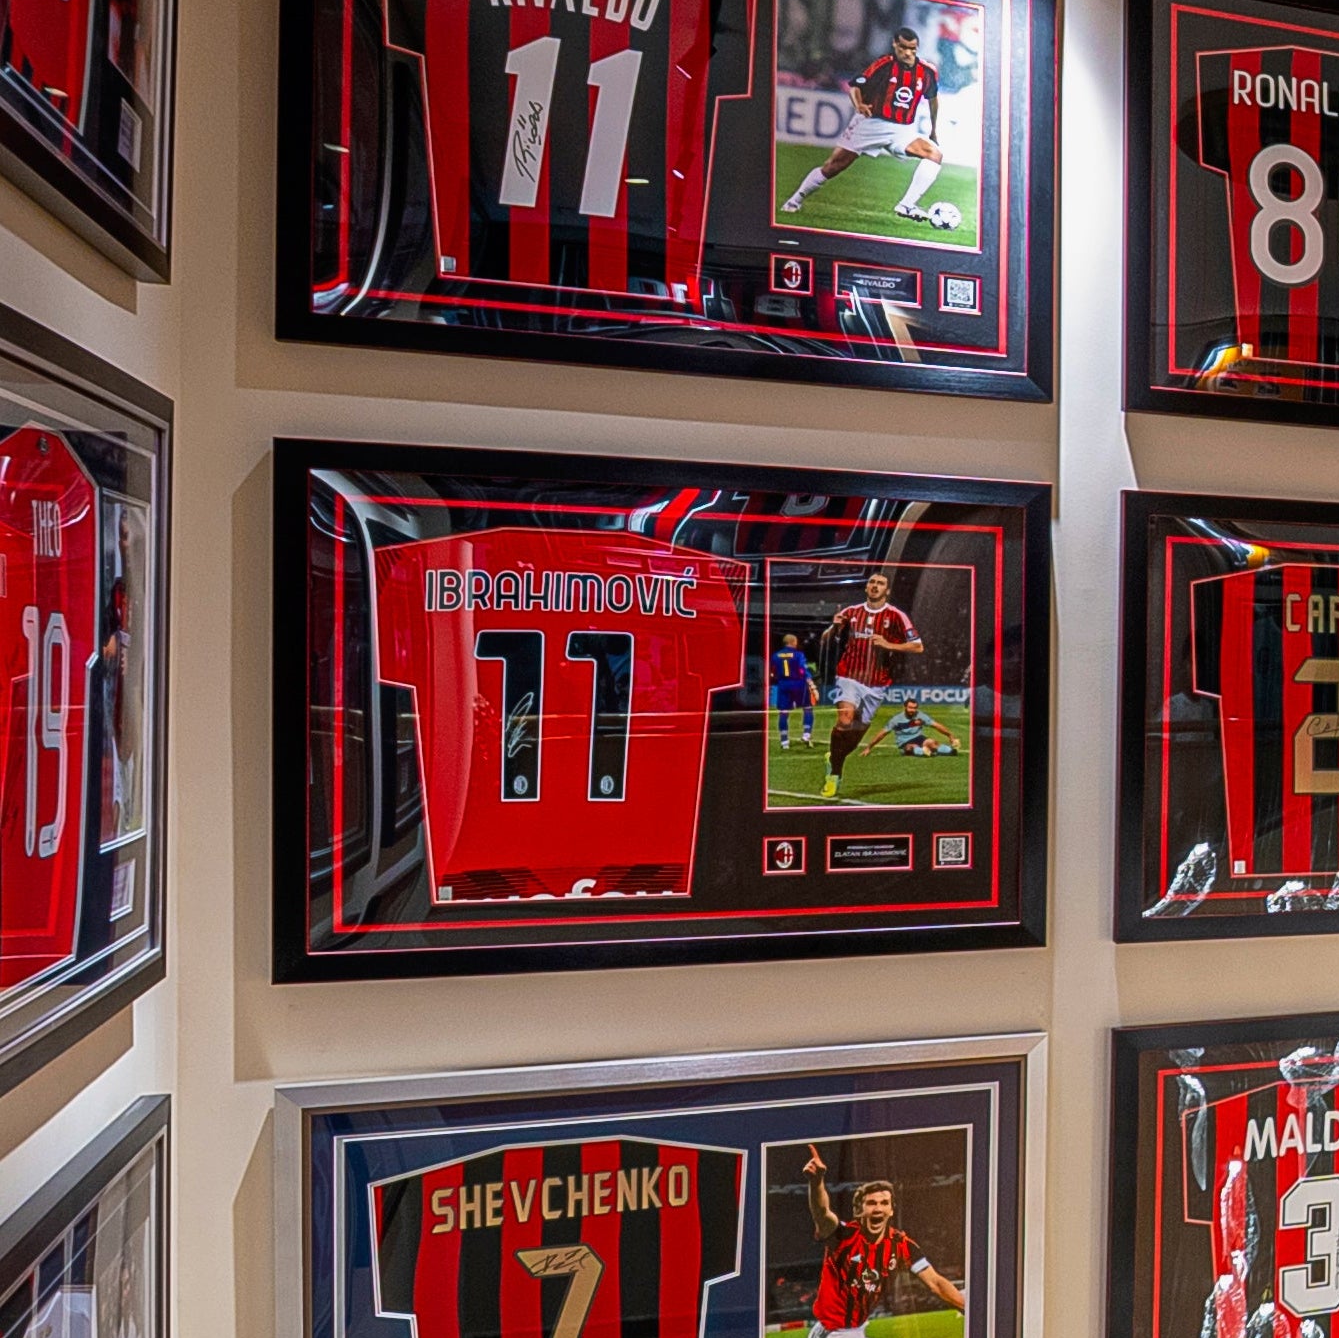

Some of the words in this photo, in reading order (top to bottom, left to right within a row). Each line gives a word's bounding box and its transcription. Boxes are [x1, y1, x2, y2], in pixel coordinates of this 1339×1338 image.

[498, 36, 644, 219] 11
[32, 500, 62, 558] THEO
[425, 567, 697, 619] IBRAHIMOVIĆ
[22, 605, 71, 858] 19
[473, 629, 635, 803] 11
[431, 1164, 691, 1235] SHEVCHENKO
